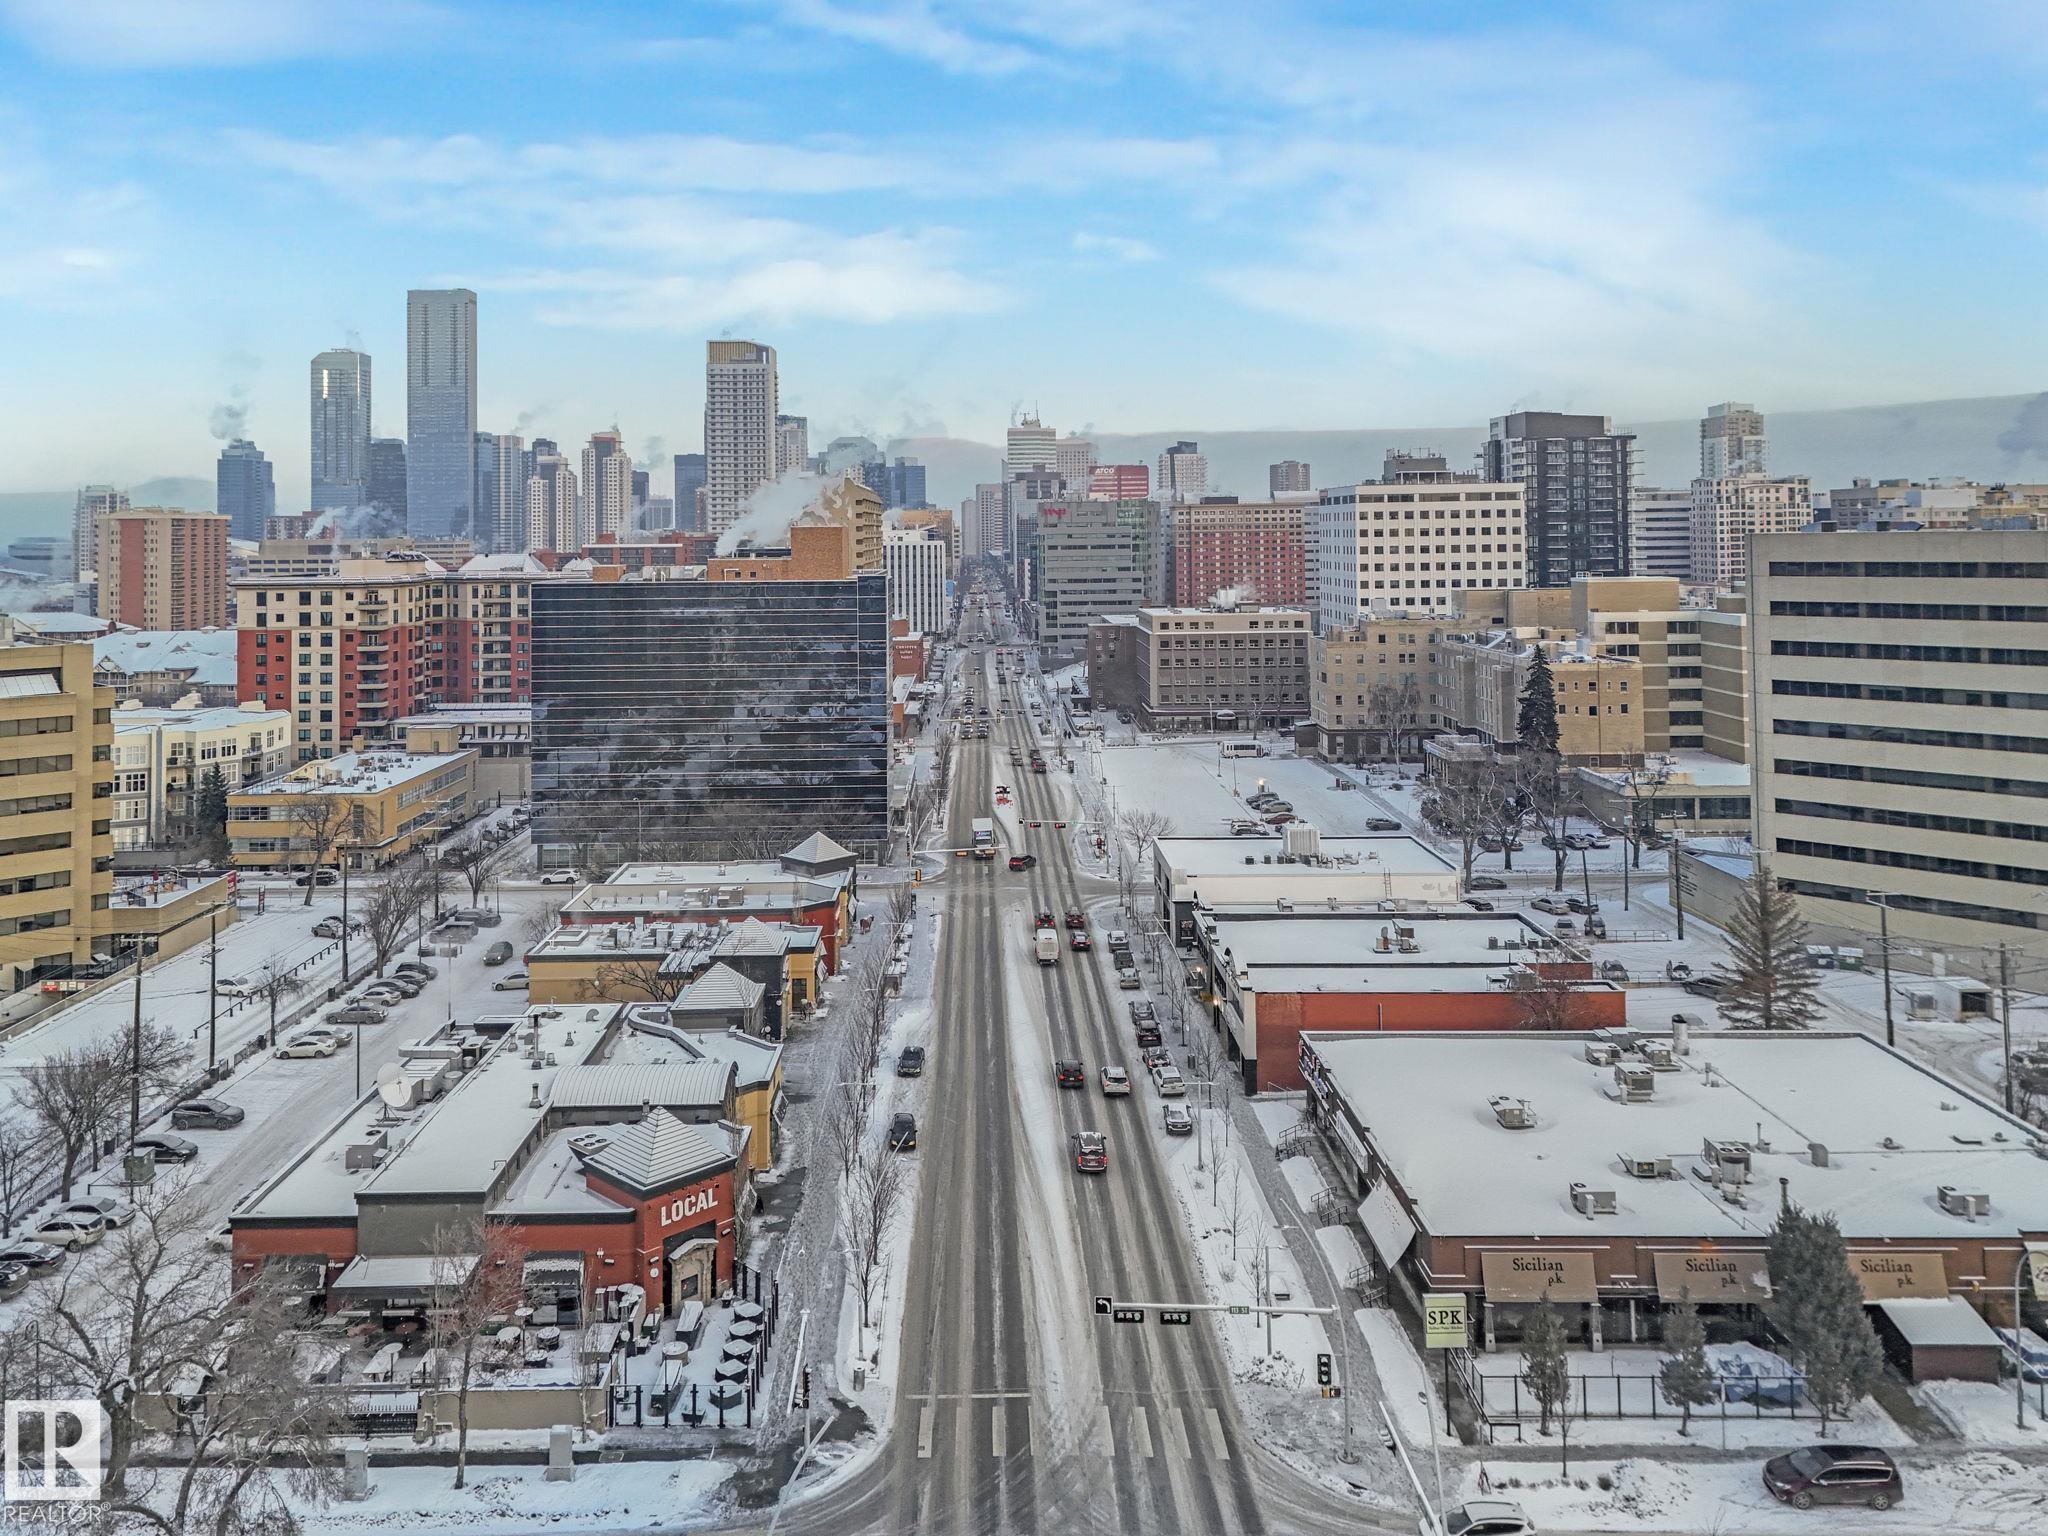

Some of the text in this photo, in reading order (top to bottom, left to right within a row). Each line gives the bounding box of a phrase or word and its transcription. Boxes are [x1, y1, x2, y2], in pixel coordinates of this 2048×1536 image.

[661, 1188, 719, 1227] LOCAL
[1512, 1257, 1563, 1271] Sicilian
[1685, 1258, 1737, 1272] Sicilian
[1860, 1258, 1913, 1273] Sicilian
